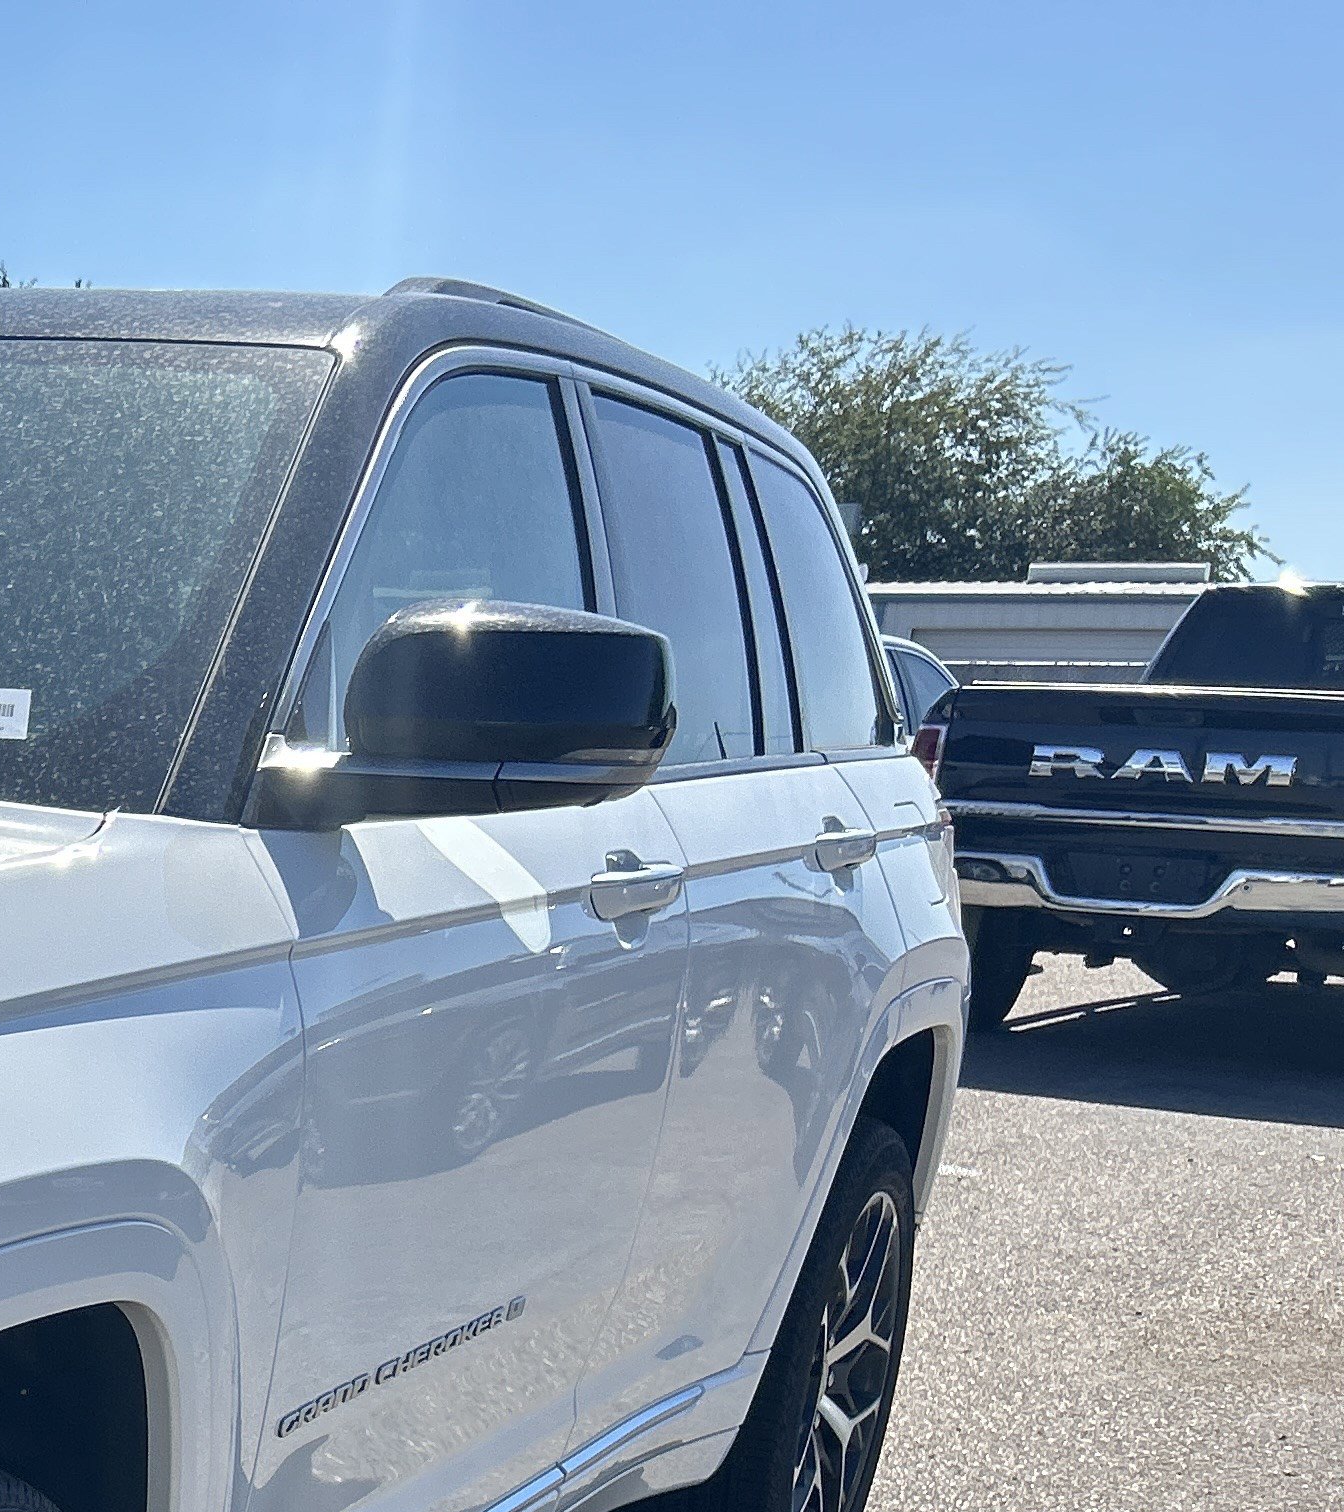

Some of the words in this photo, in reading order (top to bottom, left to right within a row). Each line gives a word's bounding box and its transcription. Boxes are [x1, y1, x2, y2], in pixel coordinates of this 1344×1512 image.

[1028, 744, 1299, 787] RAM
[274, 1371, 372, 1439] GRAND
[375, 1305, 505, 1386] CHEROKEE
